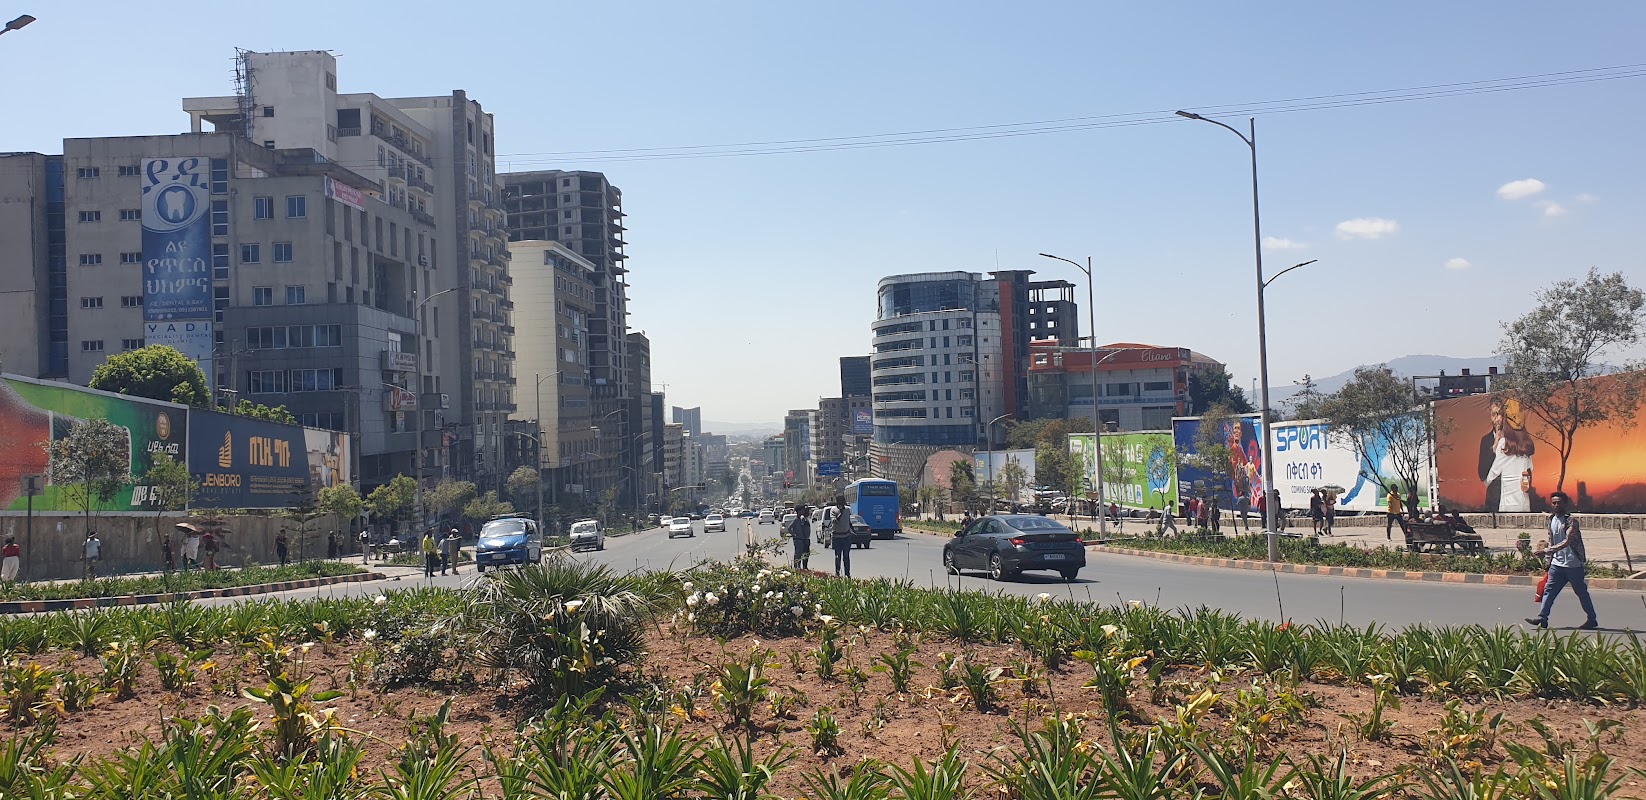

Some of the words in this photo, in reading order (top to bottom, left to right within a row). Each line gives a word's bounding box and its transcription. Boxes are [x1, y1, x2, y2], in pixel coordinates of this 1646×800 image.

[147, 278, 208, 294] ህክምና
[148, 323, 208, 332] YADI
[1141, 350, 1172, 361] Eliana
[1277, 424, 1329, 451] SPORT
[1287, 461, 1308, 479] በቅርብ
[1311, 463, 1322, 479] ቀን
[202, 473, 241, 487] JENBORO
